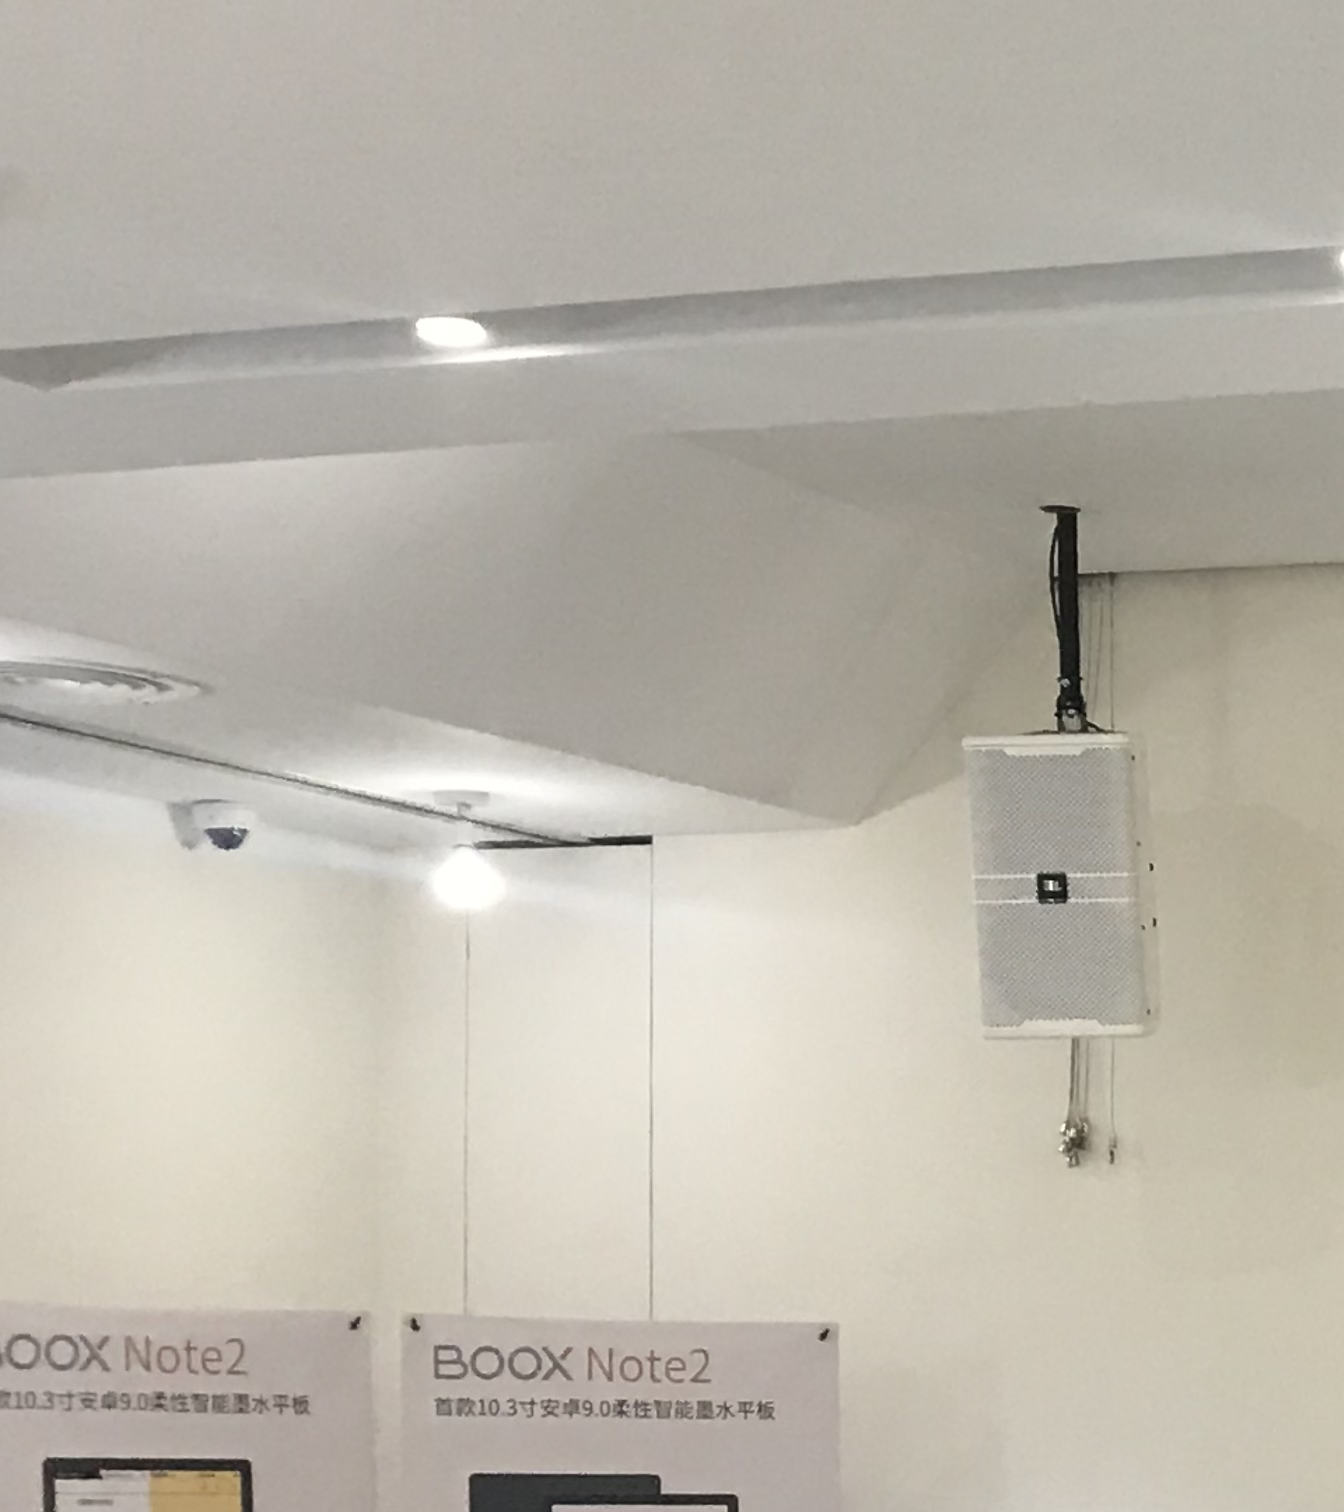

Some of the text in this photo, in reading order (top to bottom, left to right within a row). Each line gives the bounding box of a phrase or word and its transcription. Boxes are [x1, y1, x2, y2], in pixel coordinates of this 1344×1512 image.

[0, 1333, 249, 1376] OOX Note2
[432, 1344, 712, 1384] BOOX Note2
